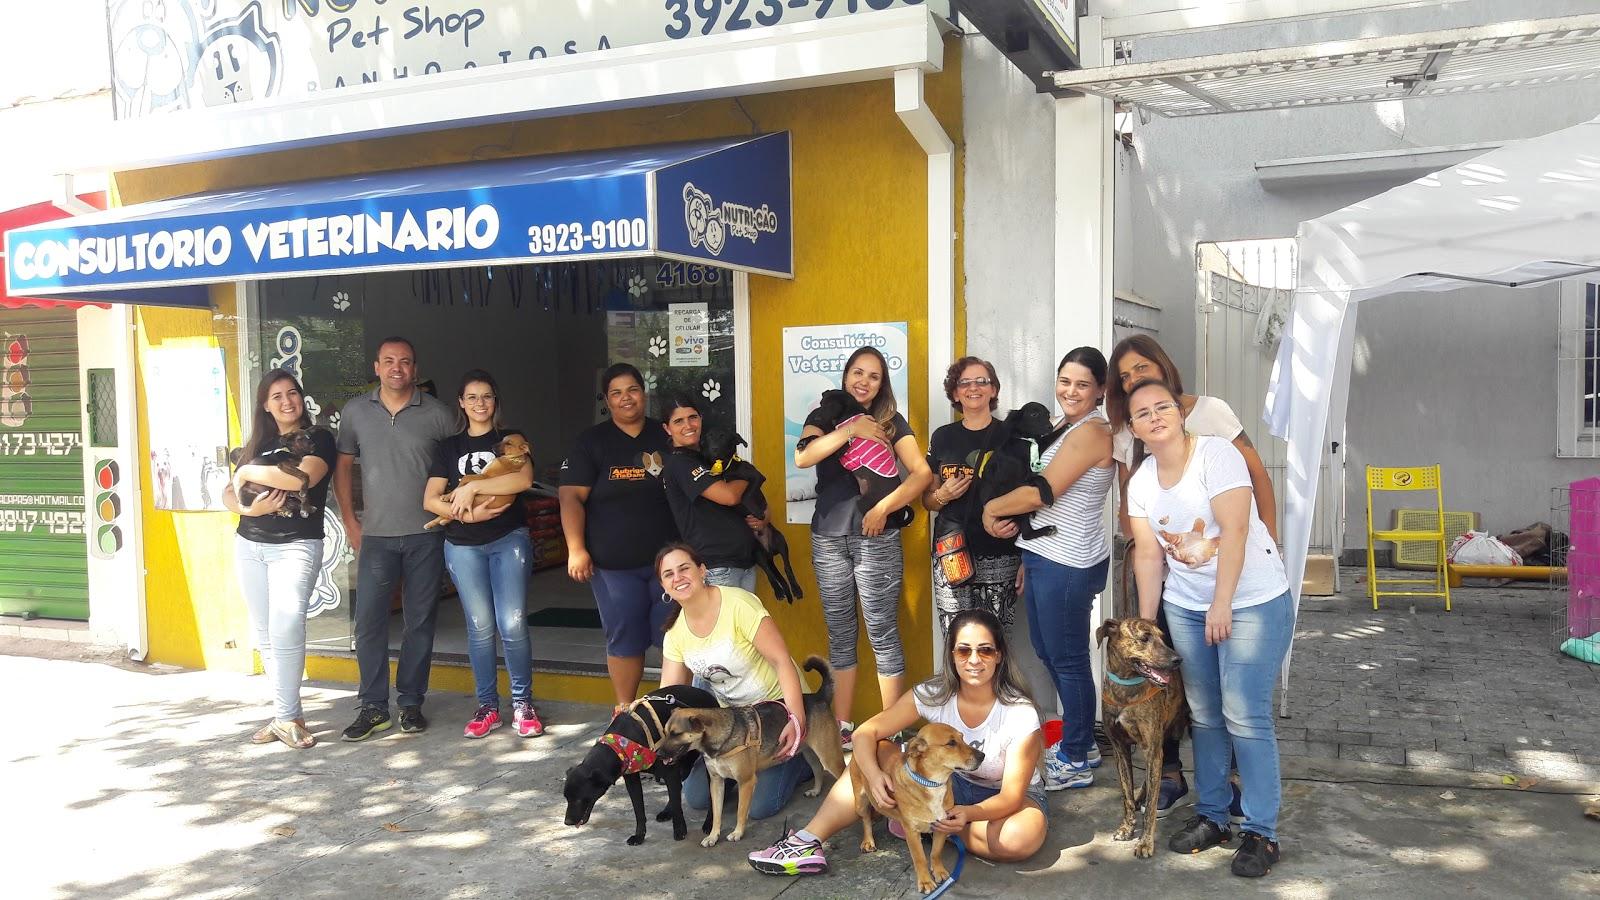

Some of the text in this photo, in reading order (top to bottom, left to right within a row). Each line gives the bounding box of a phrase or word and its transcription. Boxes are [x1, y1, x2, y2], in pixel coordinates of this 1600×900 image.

[326, 16, 389, 52] Pet
[403, 6, 485, 47] Shop
[13, 203, 500, 281] CONSULTORIO VETERINARIO
[528, 217, 646, 254] 3923-9100
[656, 262, 720, 287] 4168
[683, 335, 704, 345] vivo
[801, 333, 887, 350] Consultório
